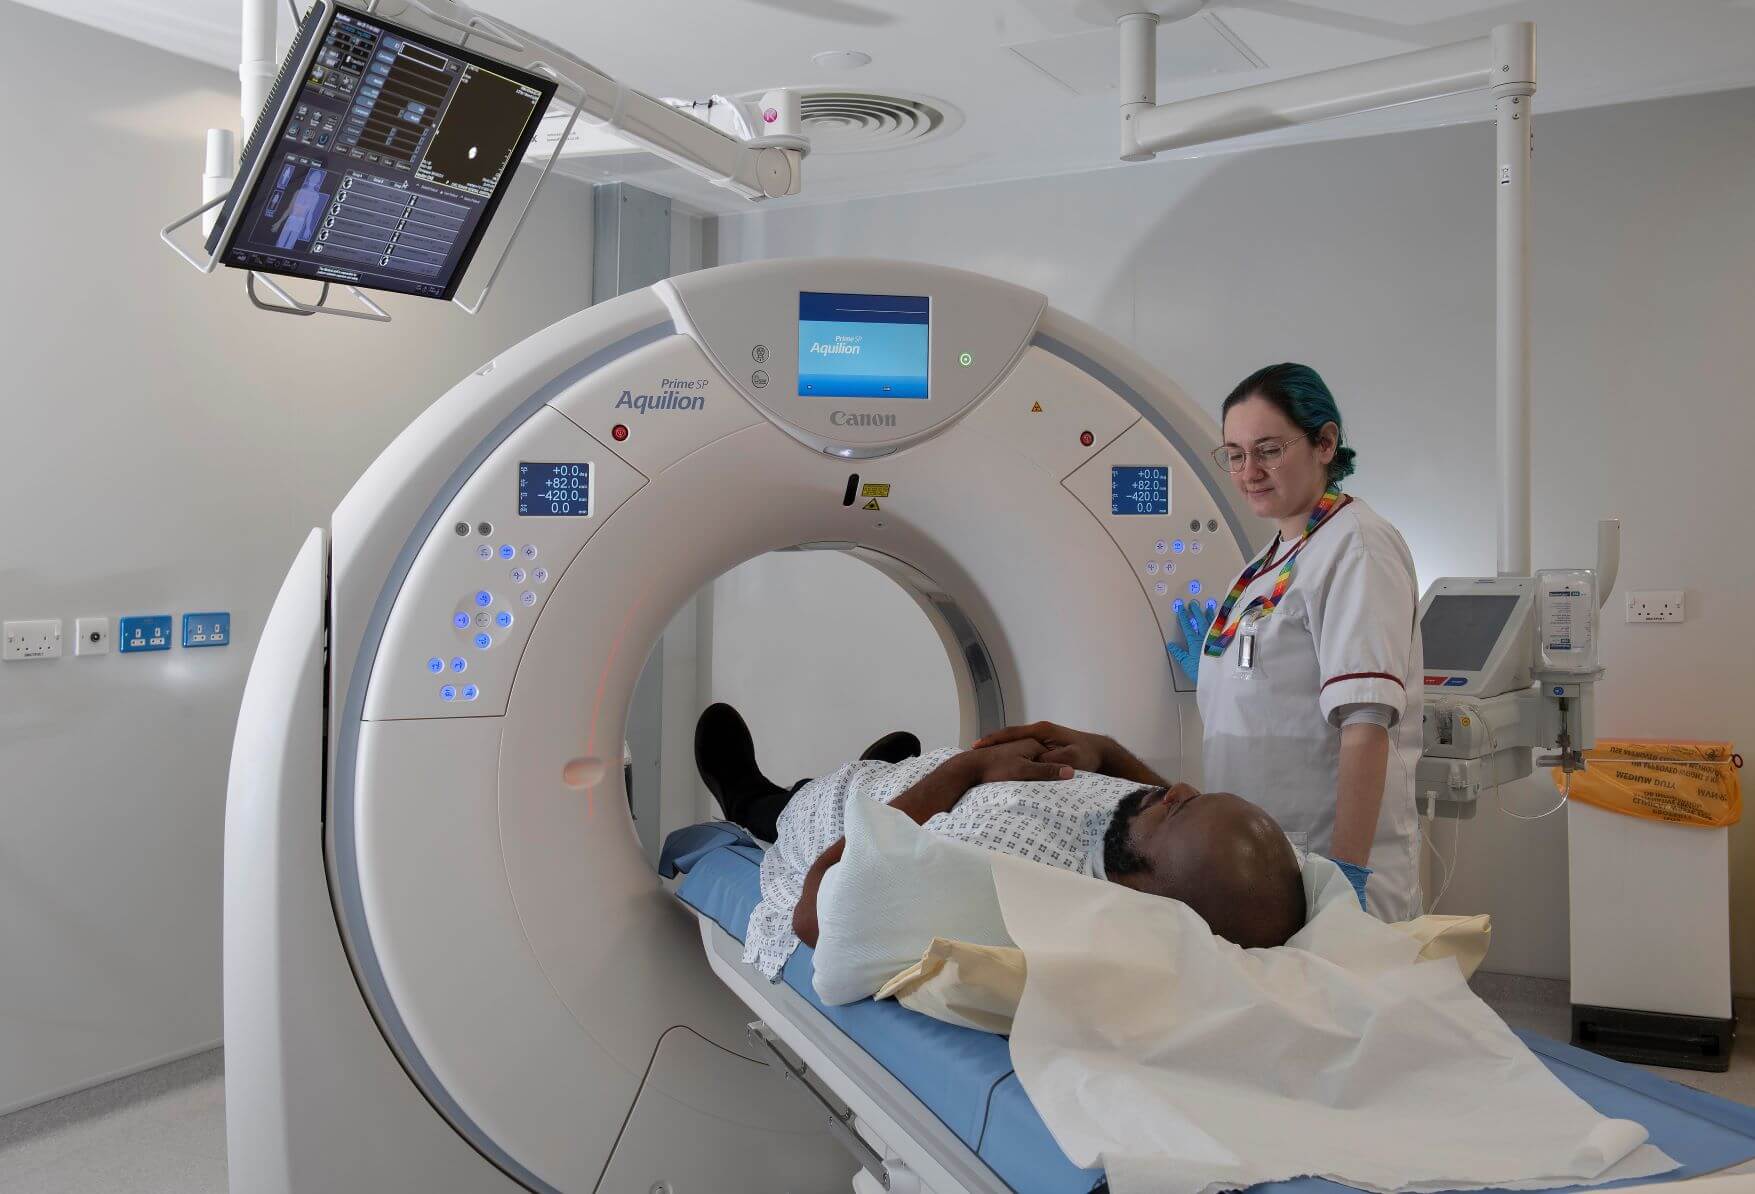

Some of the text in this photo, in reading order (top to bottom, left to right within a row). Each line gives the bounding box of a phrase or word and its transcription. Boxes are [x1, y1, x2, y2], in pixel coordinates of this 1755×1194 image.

[810, 342, 860, 357] Aquilion
[661, 378, 709, 389] Prime SP
[614, 390, 705, 414] Aquilion
[829, 410, 897, 427] Canon
[552, 465, 579, 476] +0.0
[1138, 469, 1159, 479] +0.0
[545, 477, 579, 489] +82.0
[1131, 480, 1159, 490] +82.0
[551, 502, 570, 513] 0.0
[1137, 502, 1152, 513] 0.0
